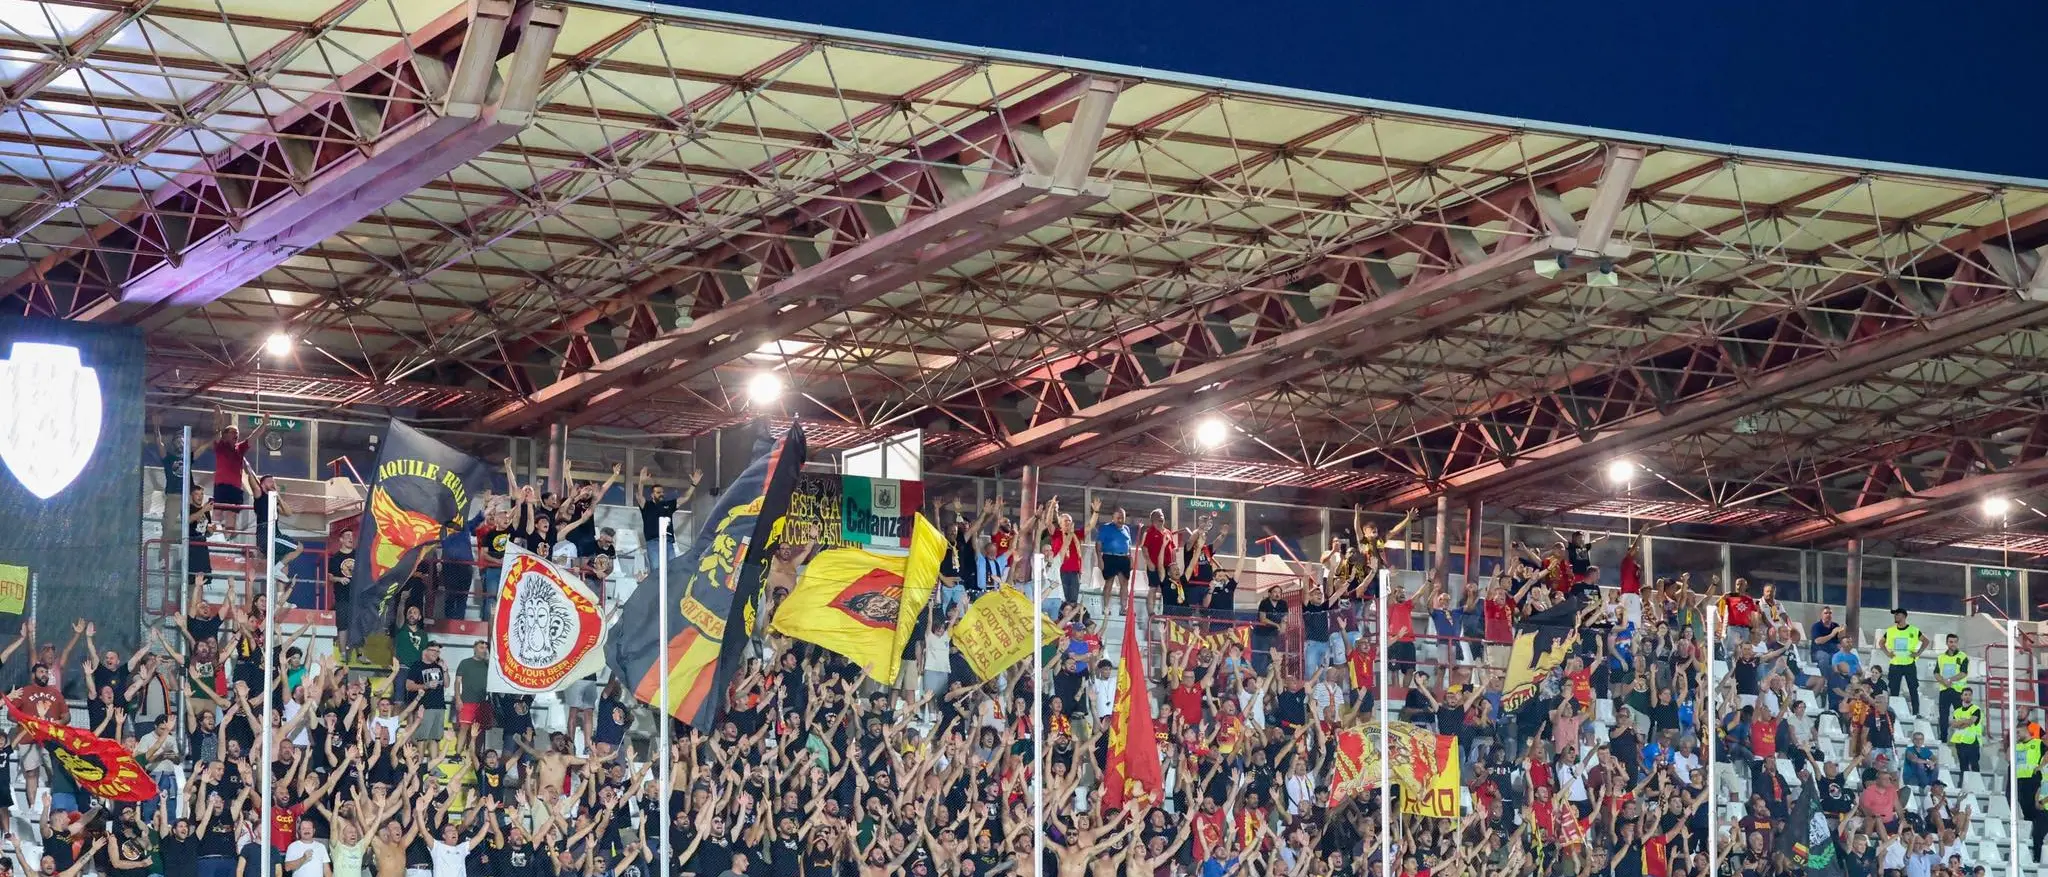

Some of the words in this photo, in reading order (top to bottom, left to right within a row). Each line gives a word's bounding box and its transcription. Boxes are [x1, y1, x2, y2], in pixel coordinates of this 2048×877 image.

[254, 417, 282, 427] USITA
[379, 459, 440, 482] AQUILE
[785, 491, 817, 519] EST
[820, 496, 843, 520] GA
[1190, 499, 1215, 508] USCITA
[846, 495, 915, 538] Catanzar
[779, 518, 813, 546] OCCE
[1981, 568, 2001, 576] USCITA
[503, 662, 515, 676] WE
[514, 673, 538, 686] FUCK
[521, 666, 546, 677] YOUR
[546, 660, 570, 676] BEER
